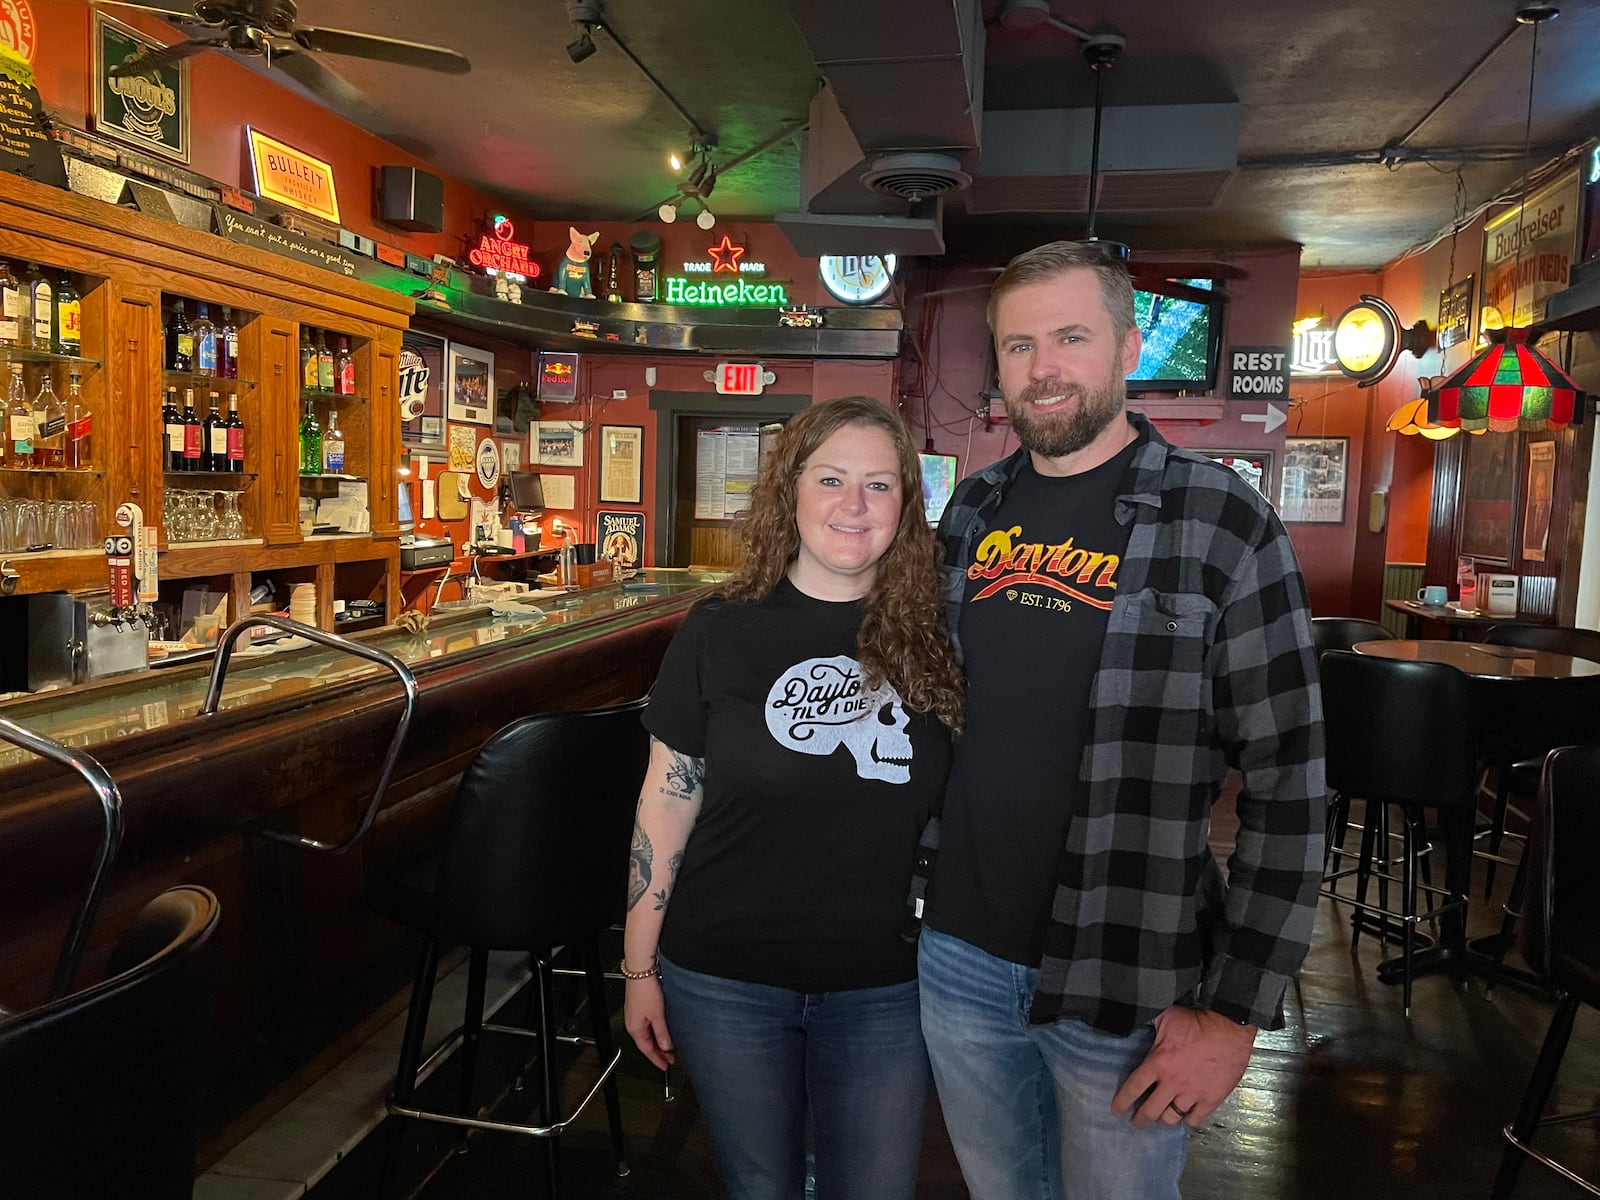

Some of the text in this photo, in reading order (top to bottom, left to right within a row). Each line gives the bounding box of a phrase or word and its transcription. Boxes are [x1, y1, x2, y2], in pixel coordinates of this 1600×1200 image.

[0, 81, 21, 93] ong
[5, 138, 31, 149] years
[22, 127, 48, 141] Train
[267, 154, 324, 190] BULLEIT
[282, 186, 318, 205] WHISKEY
[225, 214, 244, 233] You
[267, 232, 283, 245] put
[281, 239, 289, 247] a
[289, 241, 309, 255] price
[481, 236, 530, 261] ANGRY
[470, 249, 540, 278] ORCHARD
[683, 262, 765, 272] TRADE MARK
[1539, 252, 1568, 285] REDS
[665, 277, 787, 304] Heineken
[1232, 353, 1286, 371] REST
[399, 368, 428, 398] ite
[723, 366, 758, 392] EXIT
[1232, 375, 1284, 394] ROOMS
[603, 515, 640, 527] SAMUEL
[604, 524, 637, 535] ADAMS
[967, 525, 1120, 590] Dayton
[121, 589, 129, 605] ALE
[1020, 592, 1072, 613] EST. 1796
[773, 668, 862, 715] Dayto
[834, 703, 839, 715] I
[844, 698, 868, 713] DIE
